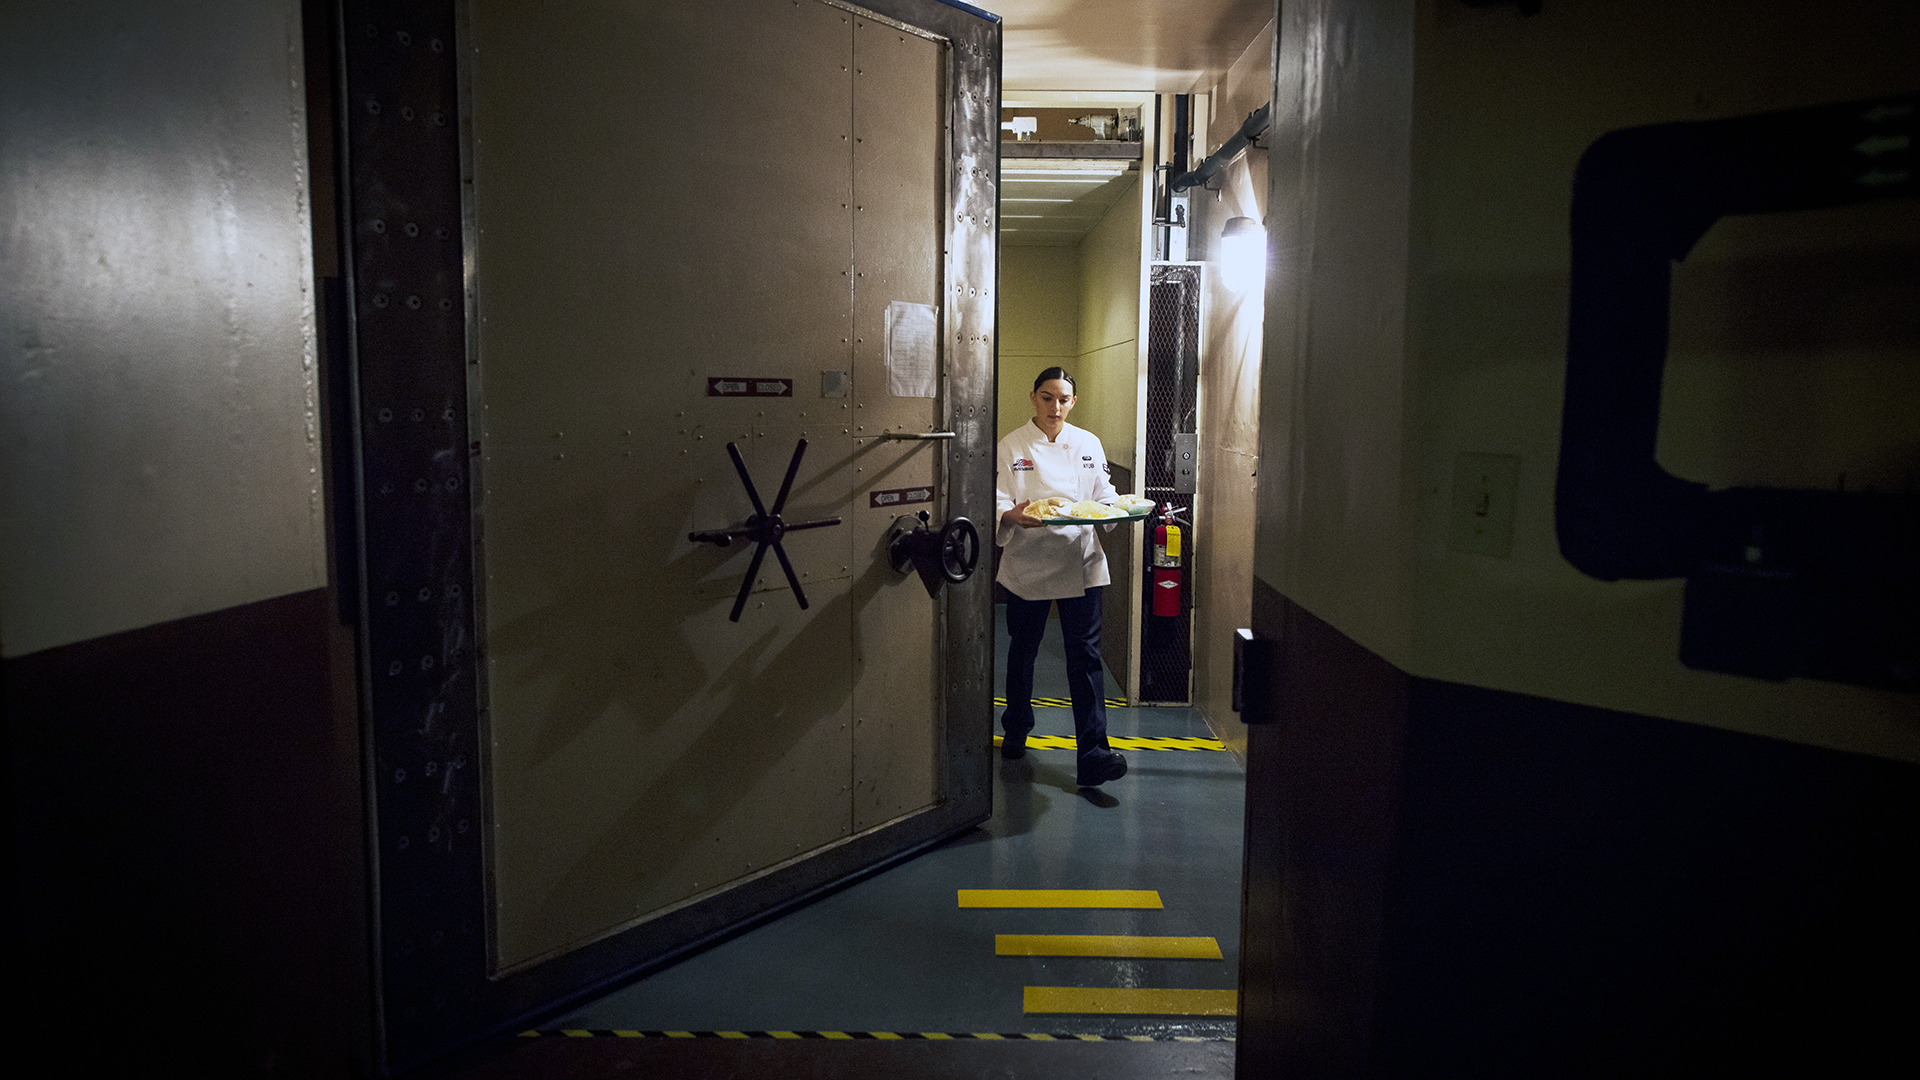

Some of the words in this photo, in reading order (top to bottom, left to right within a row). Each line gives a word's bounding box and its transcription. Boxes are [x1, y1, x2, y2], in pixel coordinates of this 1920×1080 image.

[722, 383, 740, 391] OPEN
[757, 383, 782, 391] CLOSED
[881, 494, 895, 502] OPEN
[907, 492, 926, 500] CLOSED
